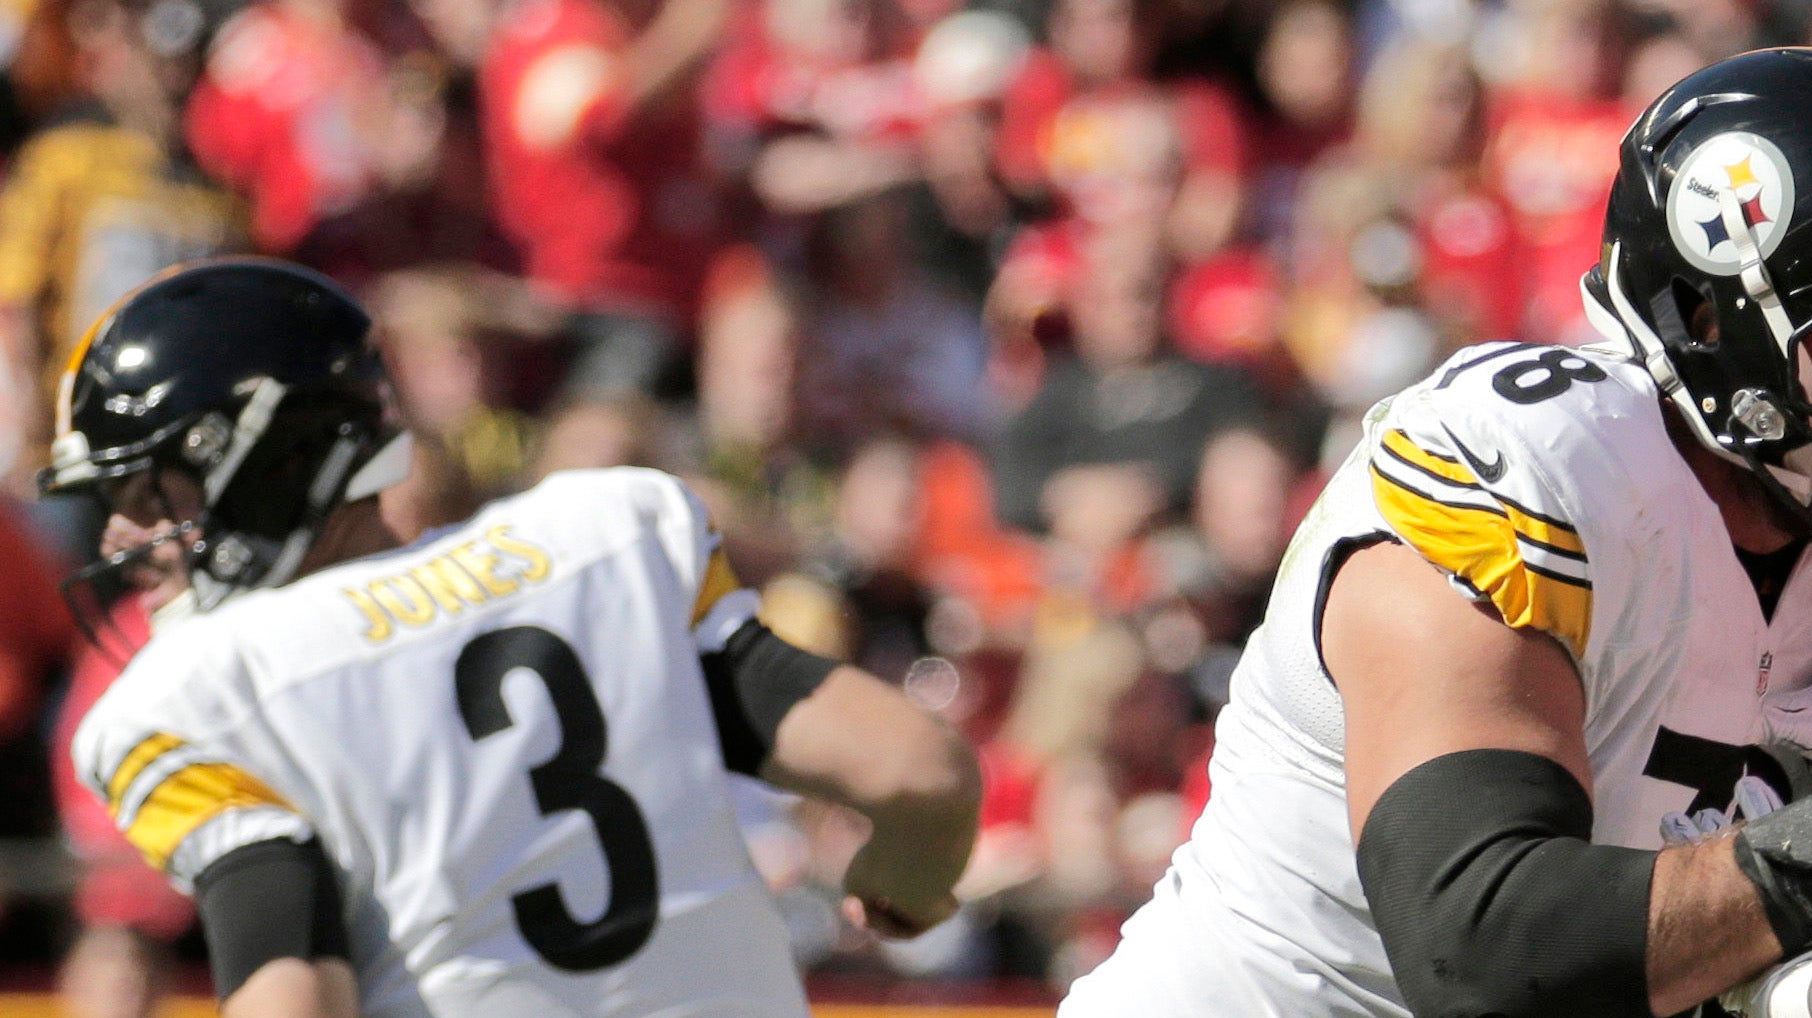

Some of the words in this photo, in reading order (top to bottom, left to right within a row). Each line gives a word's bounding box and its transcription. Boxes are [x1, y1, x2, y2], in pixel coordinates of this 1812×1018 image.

[1687, 176, 1720, 203] Steeler
[341, 524, 550, 642] JONES
[455, 625, 660, 973] 3
[1642, 724, 1794, 824] 7
